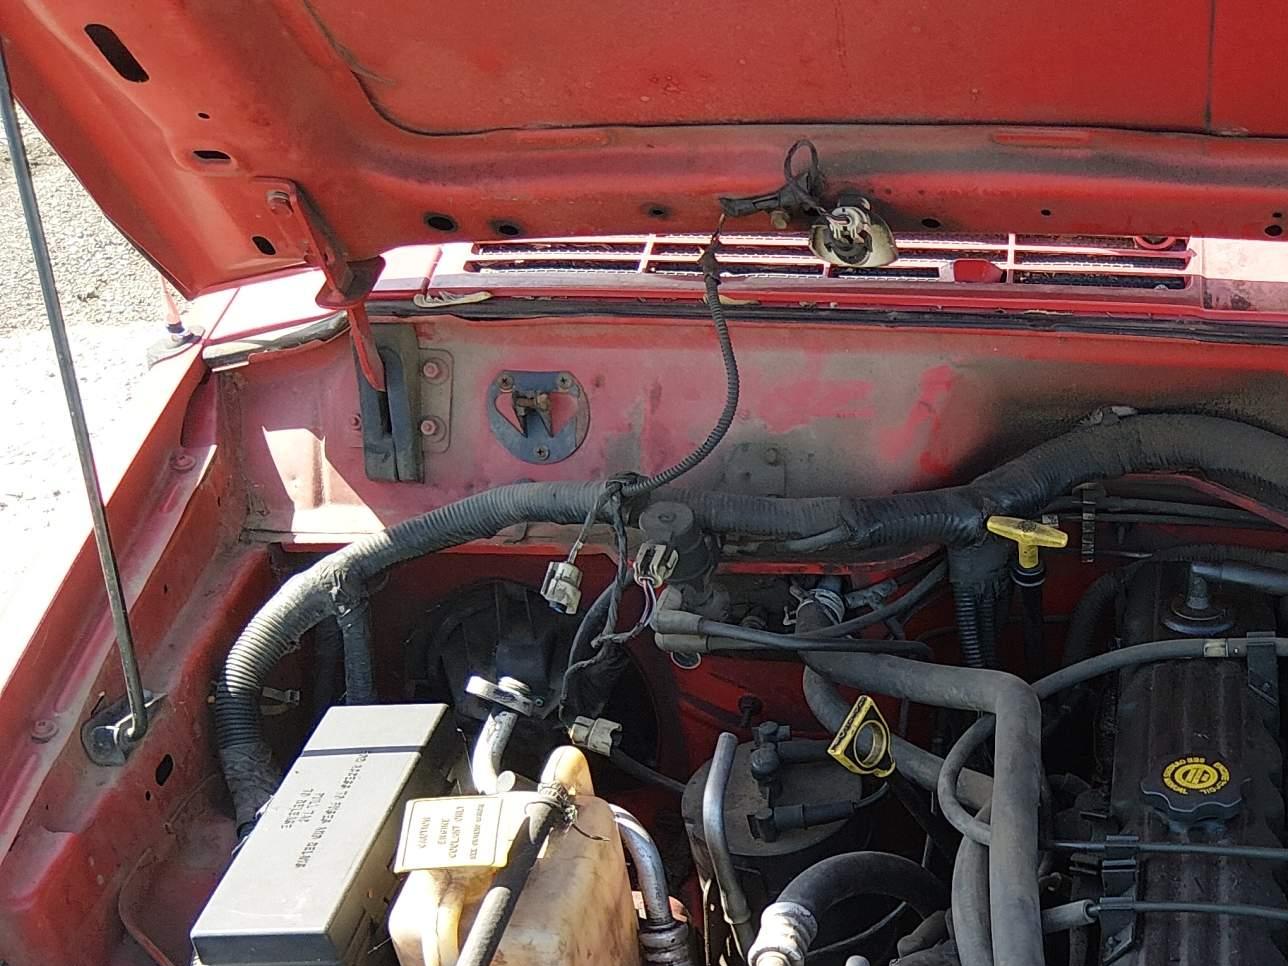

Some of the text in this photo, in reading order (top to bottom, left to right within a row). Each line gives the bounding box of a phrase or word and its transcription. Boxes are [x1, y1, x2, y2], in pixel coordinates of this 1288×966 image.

[418, 816, 431, 849] CAUTION
[437, 817, 450, 845] ENGINE
[448, 805, 464, 860] COOLANT ONLY
